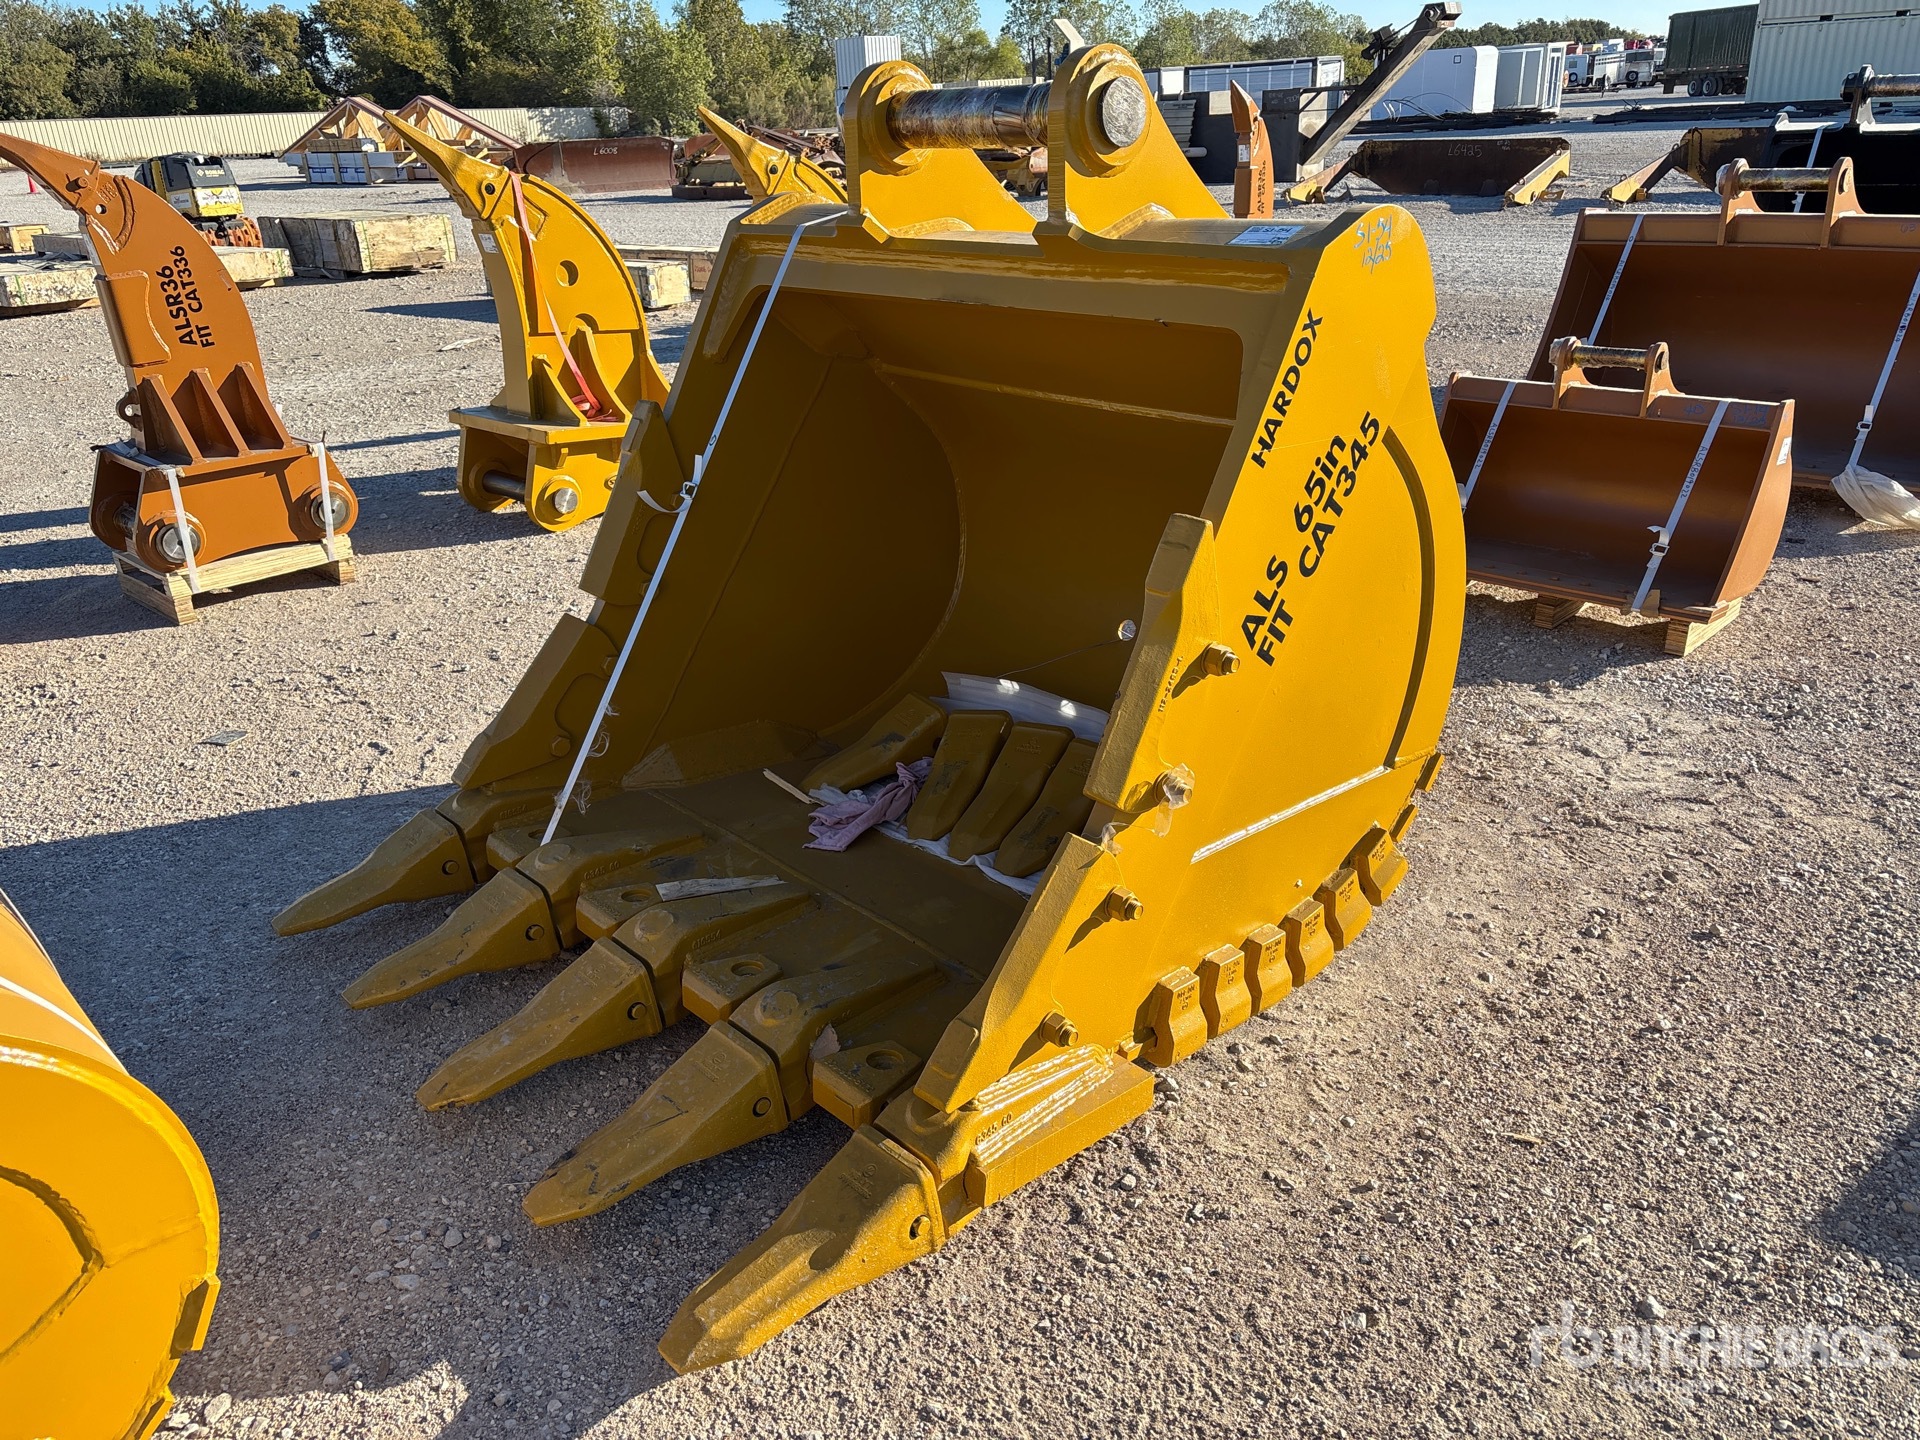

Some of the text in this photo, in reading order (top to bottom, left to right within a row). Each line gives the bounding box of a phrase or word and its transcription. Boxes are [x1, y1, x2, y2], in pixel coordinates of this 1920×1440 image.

[1448, 143, 1483, 158] L6425
[155, 265, 198, 346] ALSR36
[169, 245, 215, 348] FIT CAT336
[1250, 307, 1324, 469] HARDOX
[1240, 435, 1347, 651] ALS 65in
[1255, 410, 1381, 667] FIT CAT345
